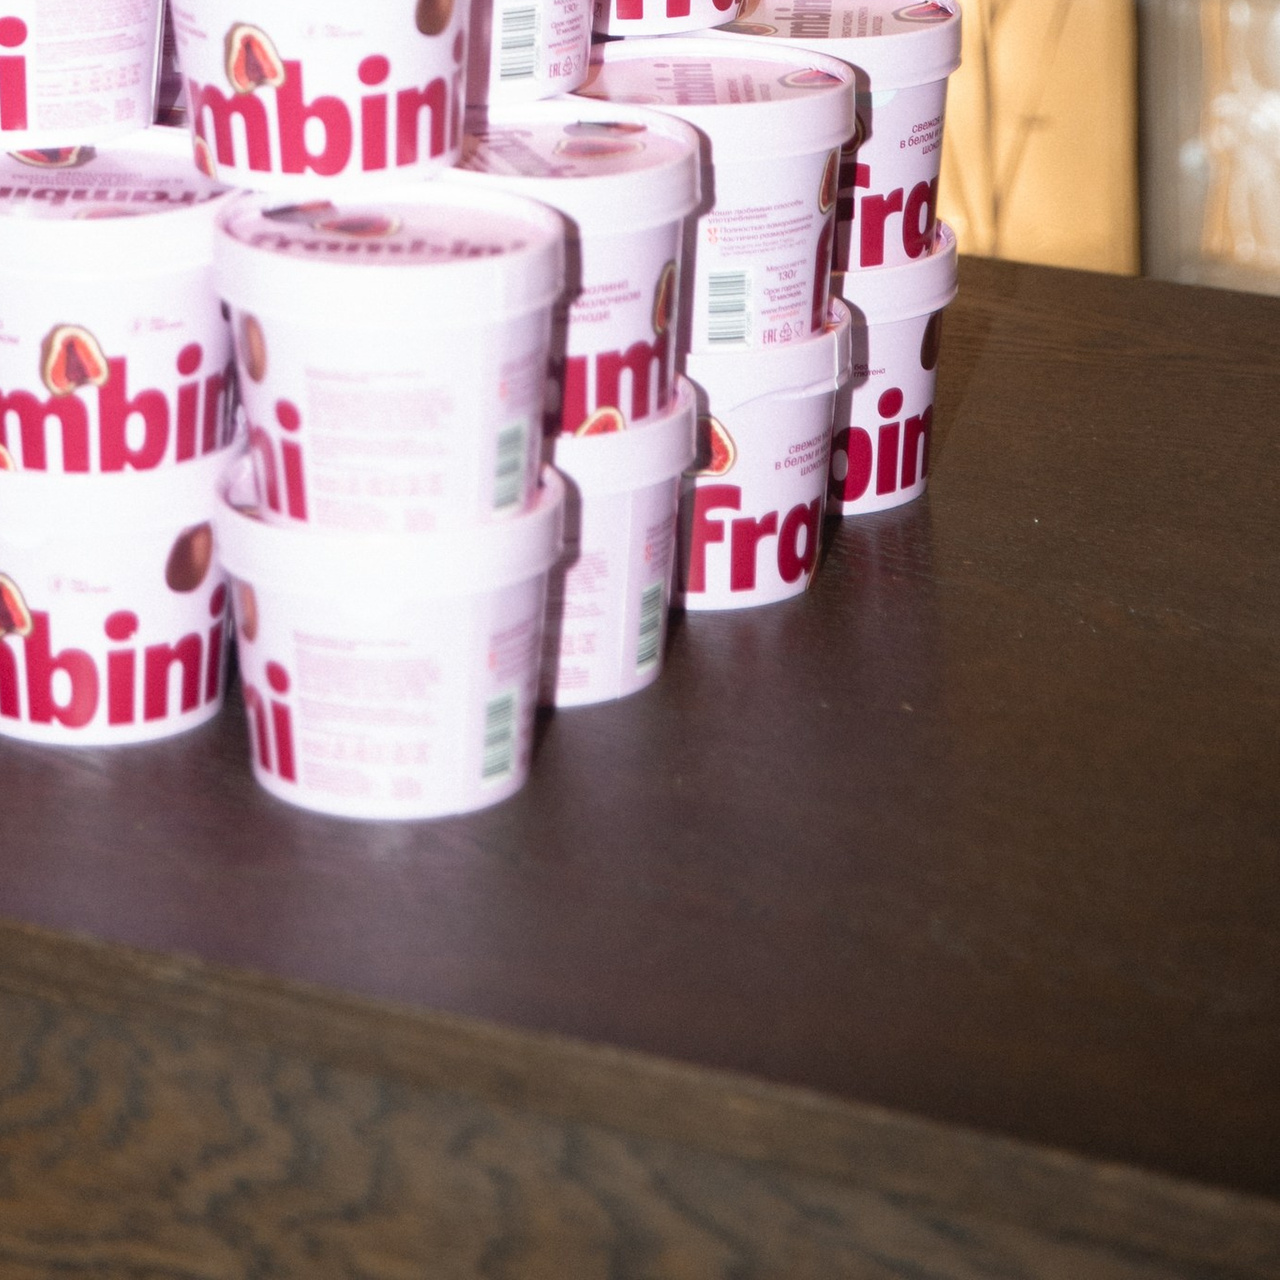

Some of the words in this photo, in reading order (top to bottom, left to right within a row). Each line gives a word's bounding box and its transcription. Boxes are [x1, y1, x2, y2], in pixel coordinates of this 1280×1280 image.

[899, 140, 906, 149] в
[907, 130, 934, 147] белом
[774, 461, 782, 471] в
[784, 450, 815, 469] белом
